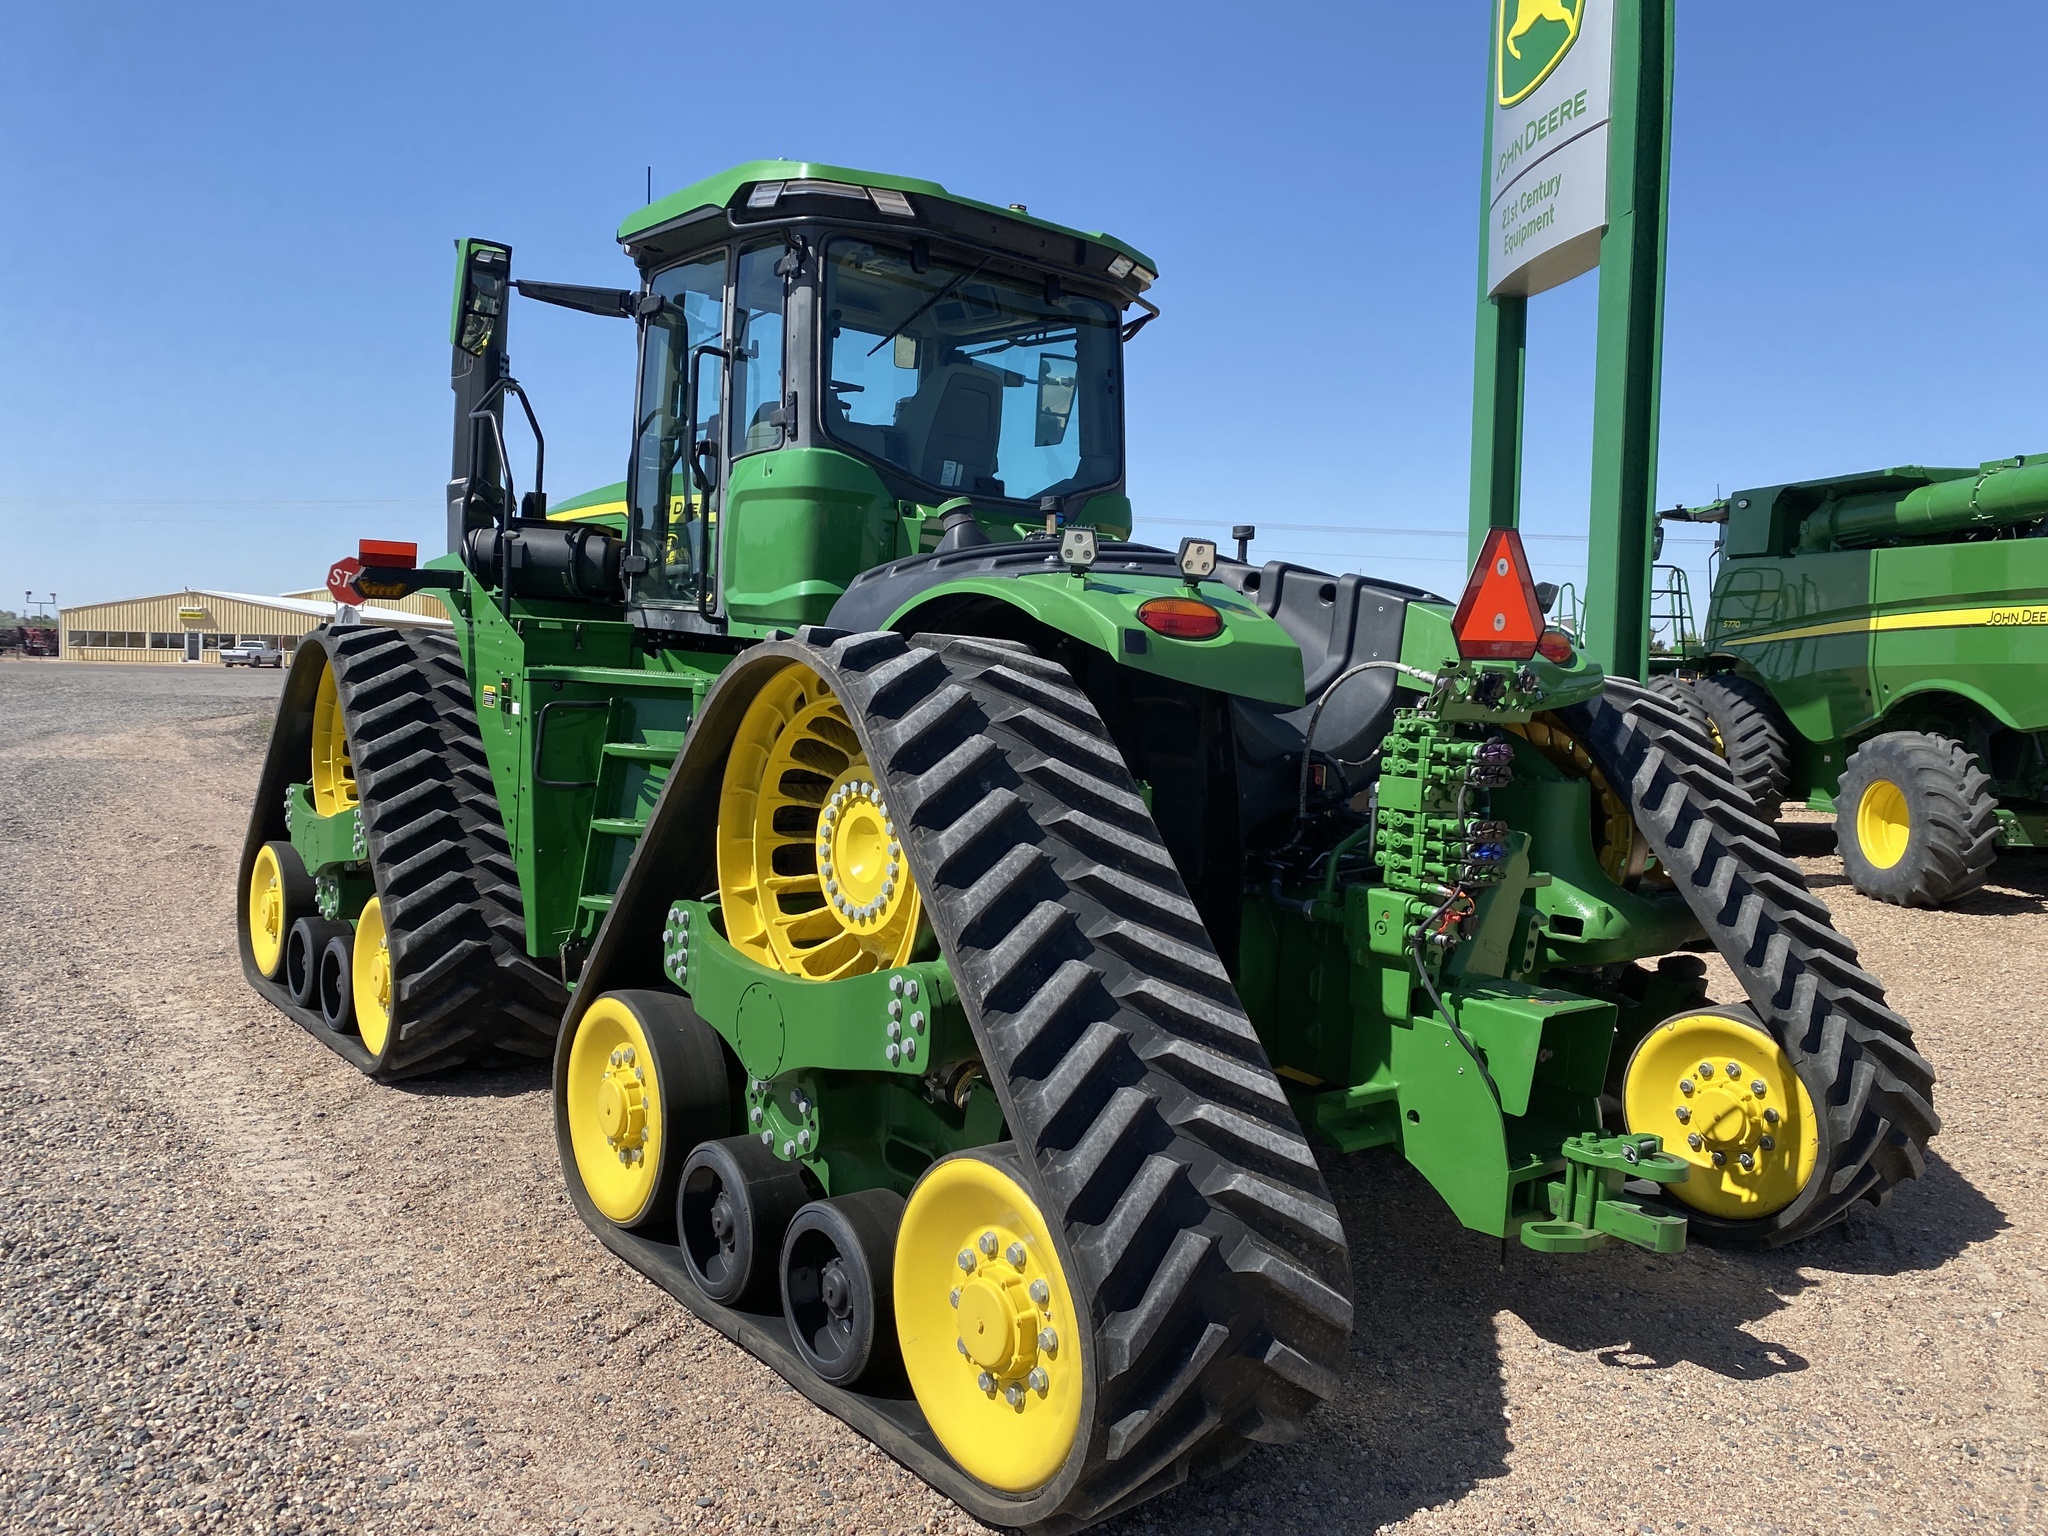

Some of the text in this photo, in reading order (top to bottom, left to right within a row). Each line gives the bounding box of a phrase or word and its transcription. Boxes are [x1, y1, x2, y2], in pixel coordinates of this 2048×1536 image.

[1496, 88, 1588, 183] JOHN DEERE
[1502, 173, 1562, 230] 21st Century
[1504, 203, 1555, 256] Equipment
[330, 568, 353, 588] ST
[1986, 609, 2048, 624] JOHN DEE
